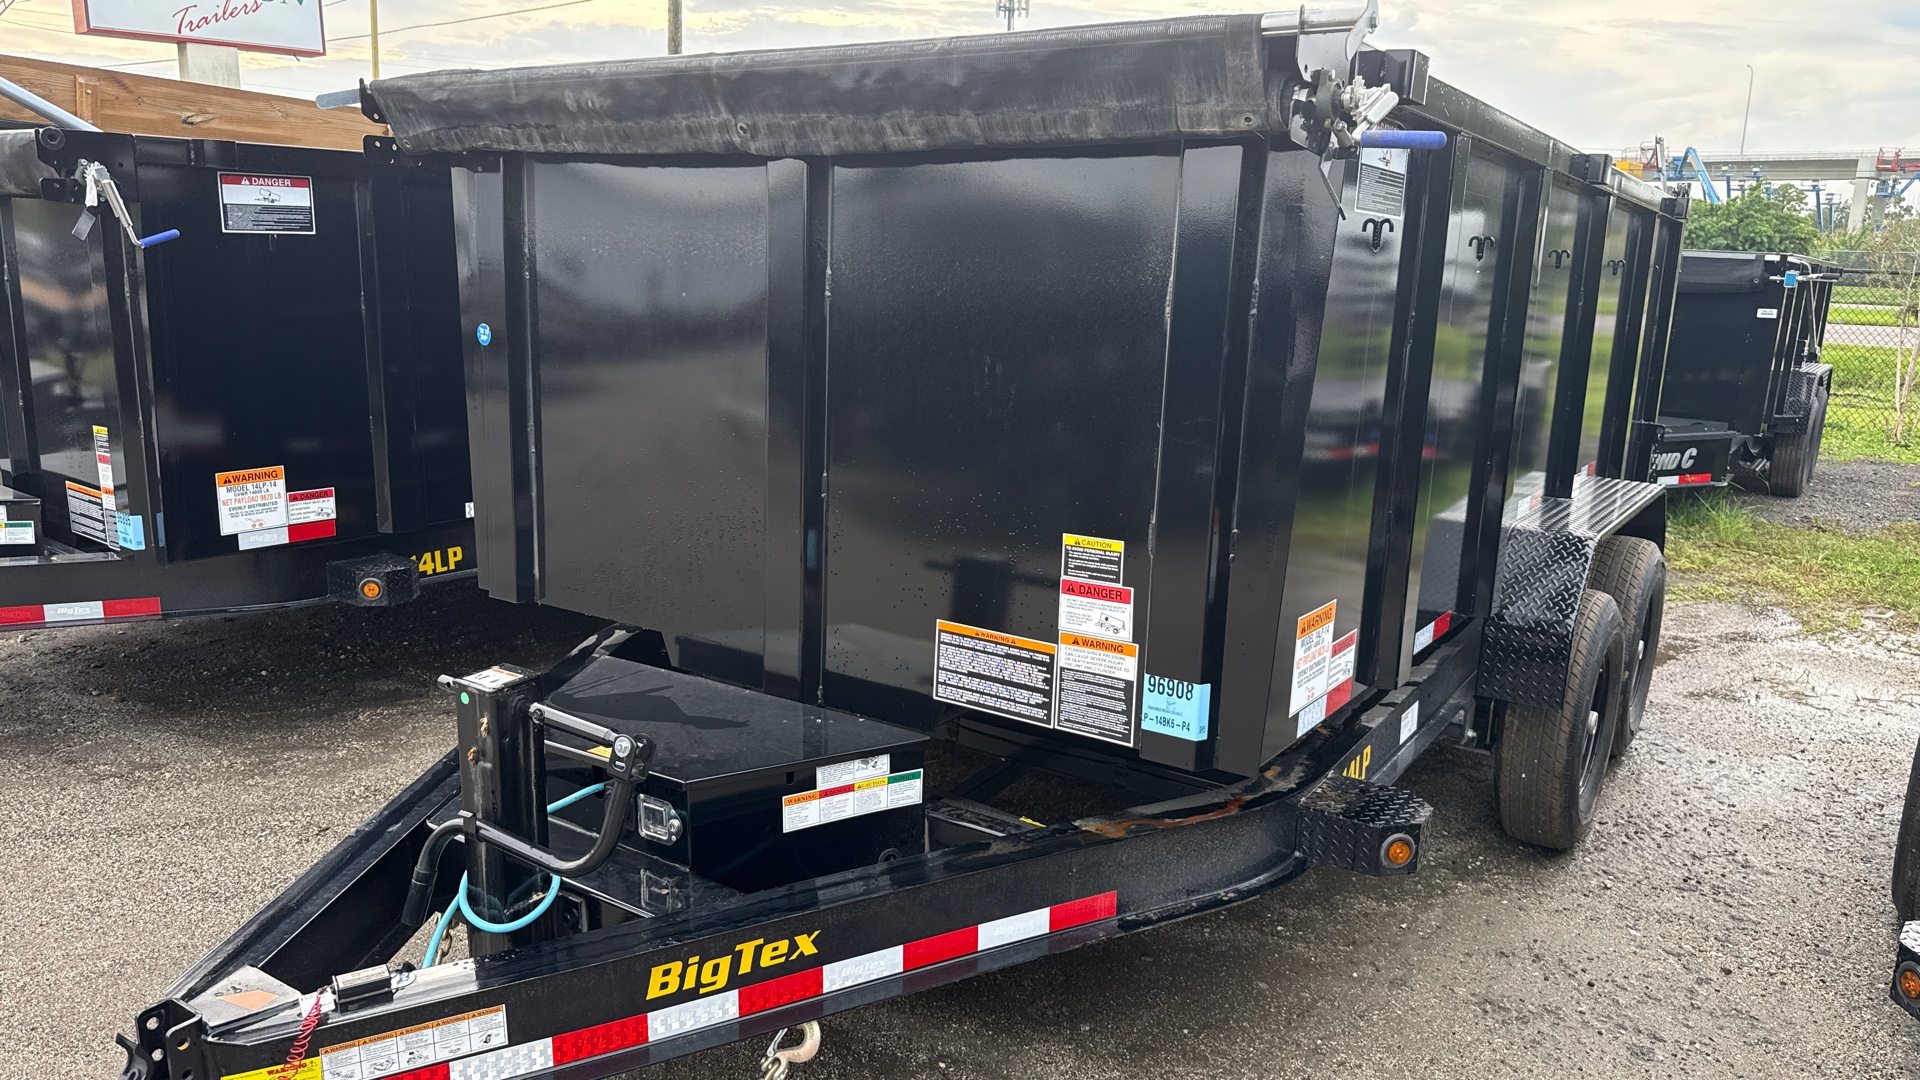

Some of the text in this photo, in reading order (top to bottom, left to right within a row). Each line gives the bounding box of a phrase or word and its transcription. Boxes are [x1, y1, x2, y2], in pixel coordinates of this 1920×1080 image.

[172, 0, 262, 35] Trailers
[252, 177, 291, 187] DANGER
[1681, 448, 1697, 469] C
[232, 470, 279, 484] WARNING
[226, 481, 277, 493] MODEL 14LP-14
[234, 494, 259, 505] PAYLOAD
[300, 491, 328, 500] DANGER
[229, 501, 278, 512] EVENLY DISTRIBUTED
[1081, 539, 1112, 549] CAUTION
[410, 546, 462, 575] 4LP
[1079, 585, 1122, 600] DANGER
[57, 606, 91, 615] BigTex
[1307, 608, 1332, 631] WARNING
[981, 632, 1010, 643] WARNING
[1082, 639, 1123, 653] WARNING
[1065, 646, 1086, 654] CYLINDER
[1103, 653, 1126, 661] PRESSURE
[1094, 667, 1115, 675] CYLINDER
[1148, 675, 1194, 701] 96908
[862, 779, 885, 788] CAUTION
[893, 774, 915, 782] NOTICE
[828, 786, 851, 796] DANGER
[788, 794, 817, 804] WARNING
[646, 930, 821, 1000] BigTex
[841, 958, 886, 977] BigTex
[477, 1007, 501, 1017] WARNING
[440, 1015, 468, 1025] WARNING
[404, 1024, 431, 1034] WARNING
[367, 1033, 394, 1044] WARNING
[329, 1042, 356, 1053] WARNING
